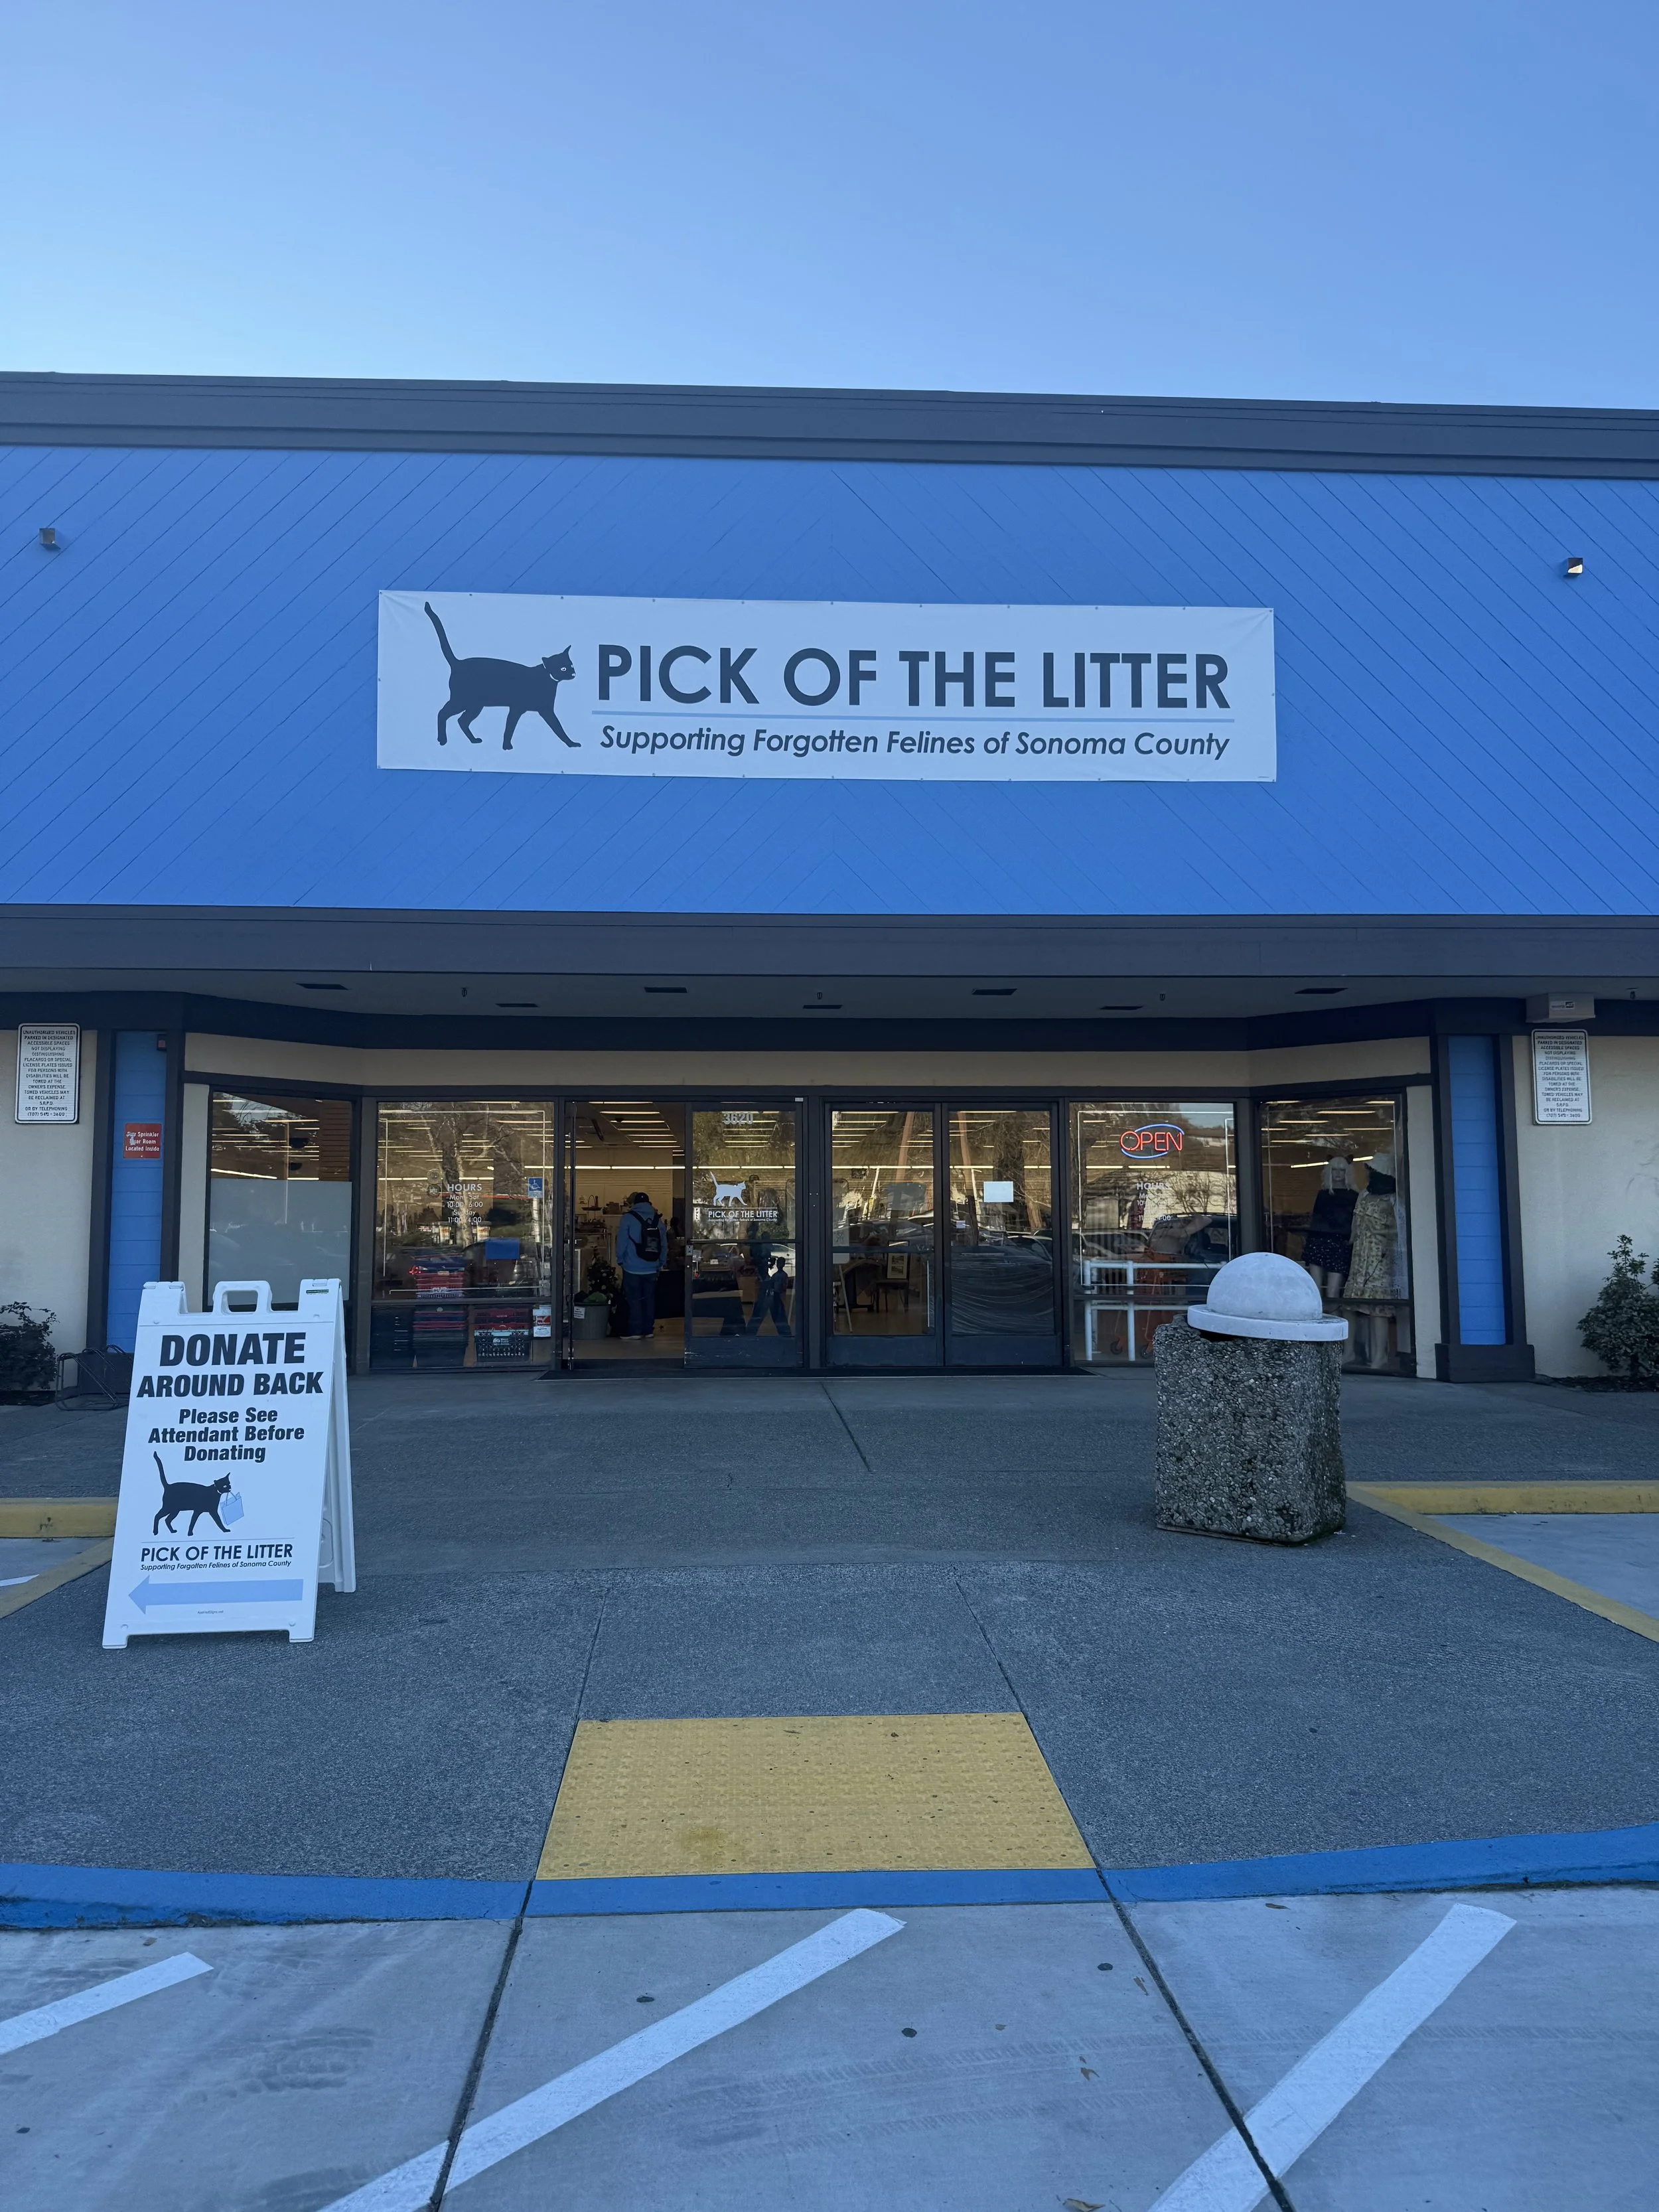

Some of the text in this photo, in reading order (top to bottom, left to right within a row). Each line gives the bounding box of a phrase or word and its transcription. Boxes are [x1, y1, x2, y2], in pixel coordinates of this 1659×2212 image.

[598, 644, 1230, 709] PICK OF THE LITTER
[600, 725, 1230, 761] Supporting Forgotten Felines of Sonoma County
[723, 1112, 754, 1125] 3620
[1119, 1131, 1183, 1151] OPEN
[159, 1332, 307, 1366] DONATE
[136, 1371, 324, 1398] AROUND BACK
[179, 1407, 278, 1424] Please See
[148, 1425, 305, 1443] Attendant Before
[184, 1444, 266, 1463] Donating
[141, 1544, 293, 1562] PICK OF THE LITTER
[140, 1563, 175, 1572] Supporting
[177, 1562, 207, 1570] Forgotten
